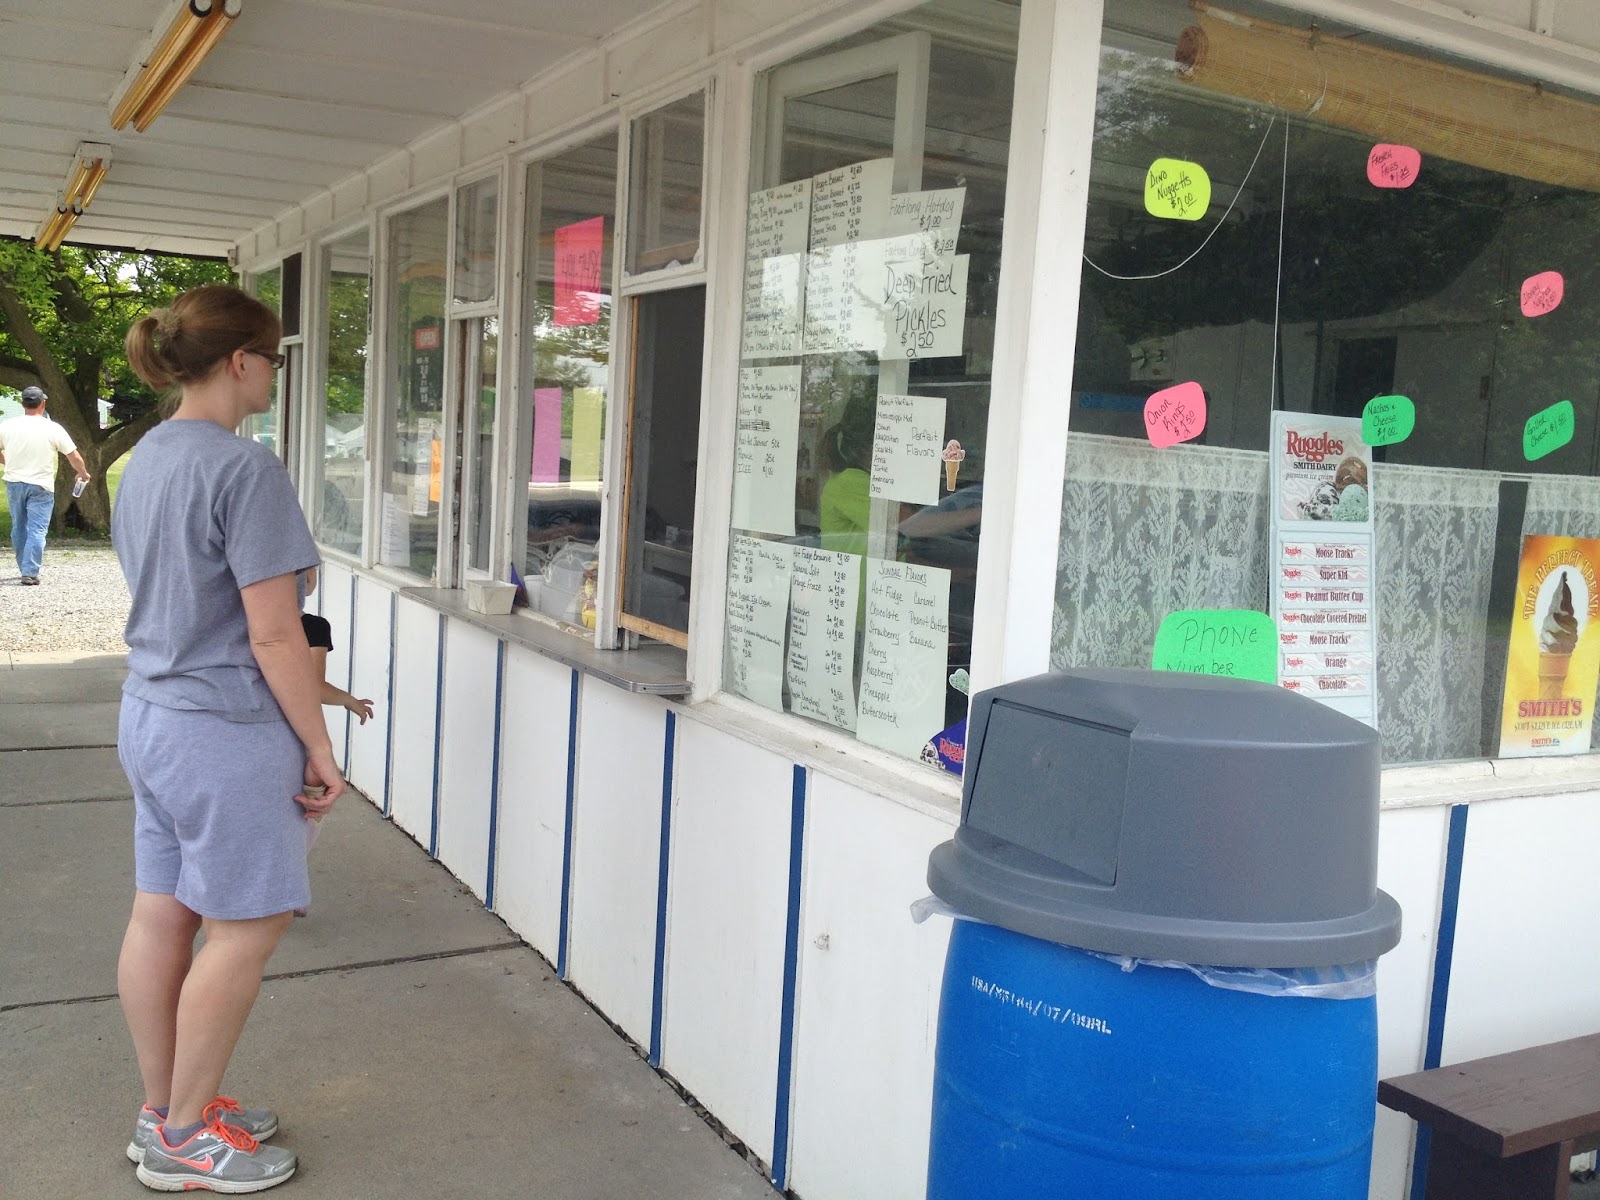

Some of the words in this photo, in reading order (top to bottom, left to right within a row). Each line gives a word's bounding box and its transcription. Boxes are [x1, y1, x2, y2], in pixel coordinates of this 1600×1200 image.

[884, 265, 915, 304] Deep
[921, 260, 957, 295] Fried
[911, 426, 939, 441] Parfait
[906, 443, 935, 458] Flavors
[1286, 430, 1344, 462] Ruggles
[1293, 461, 1316, 470] SMITH
[1317, 463, 1338, 471] DAIRY
[1315, 547, 1334, 559] Moose
[1535, 549, 1582, 584] PERFECT
[1319, 570, 1337, 581] Super
[1305, 591, 1329, 602] Peanut
[1330, 592, 1350, 602] Butter
[1351, 592, 1364, 603] Cup
[1300, 613, 1325, 624] Chocolate
[1326, 613, 1348, 624] Covered
[1348, 613, 1367, 624] Pretzel
[1309, 634, 1328, 645] Moose
[1325, 658, 1347, 669] Orange
[1318, 679, 1347, 690] Chocolate
[1518, 698, 1582, 718] SMITH'S
